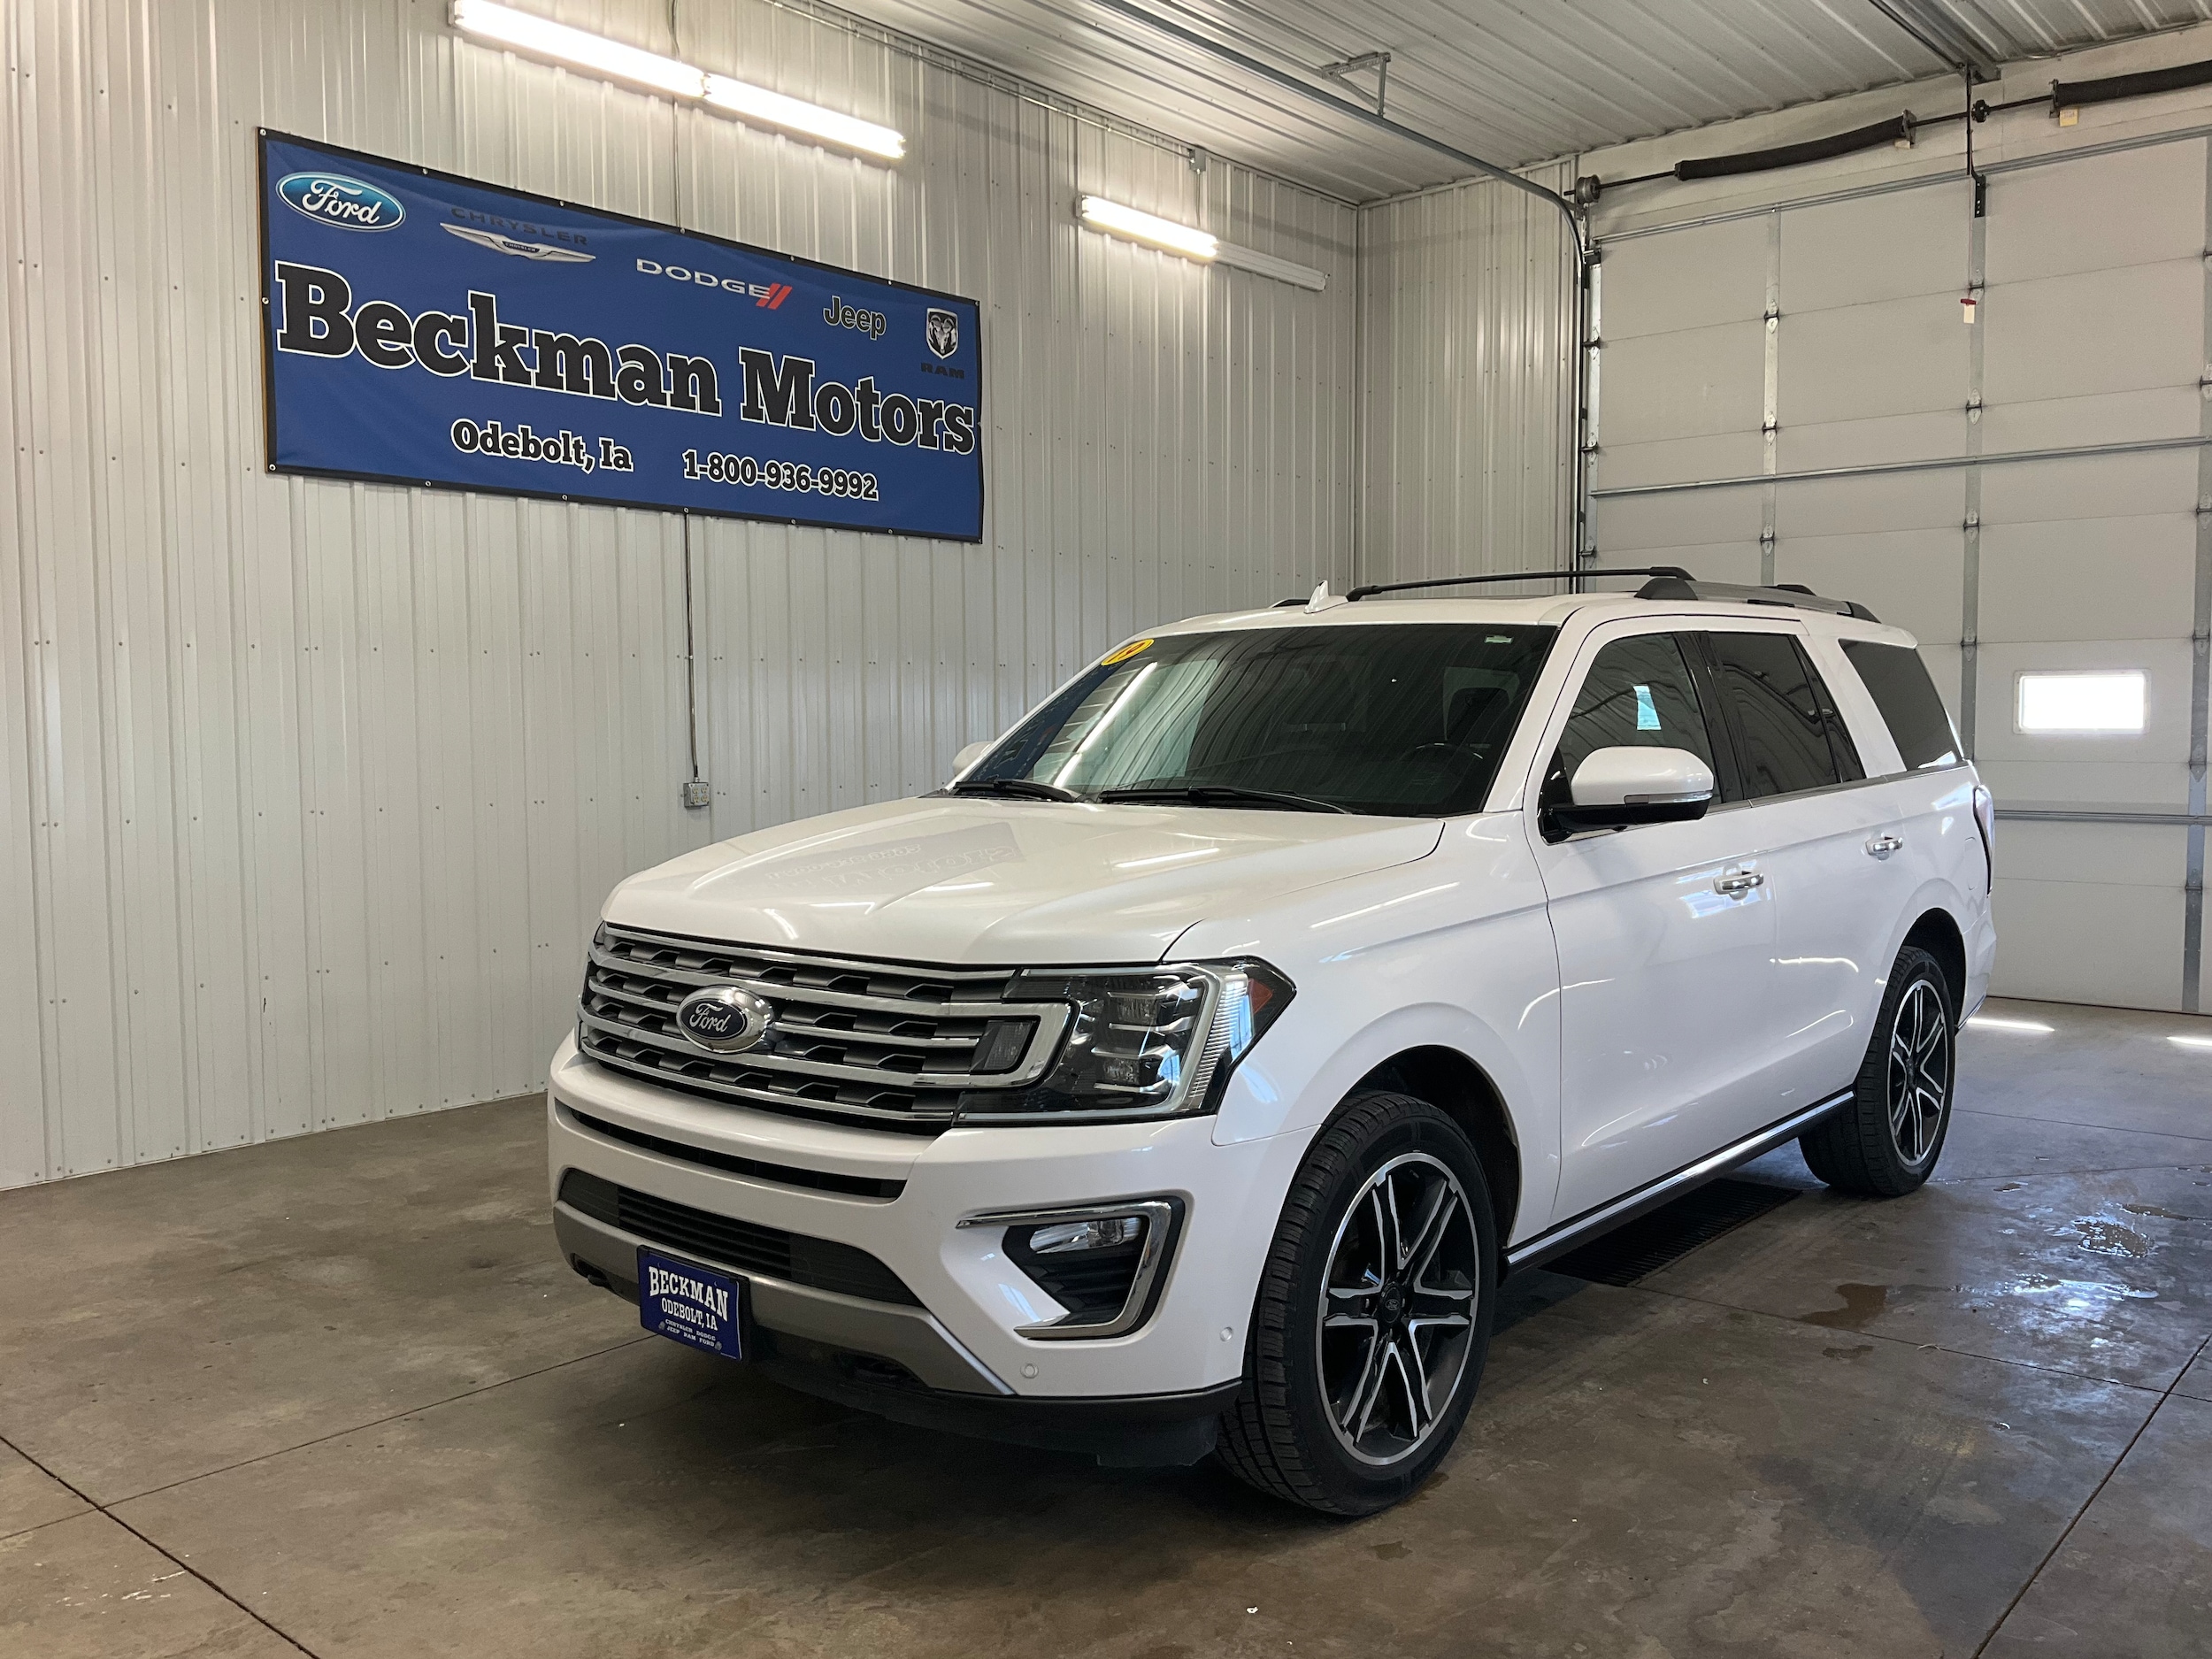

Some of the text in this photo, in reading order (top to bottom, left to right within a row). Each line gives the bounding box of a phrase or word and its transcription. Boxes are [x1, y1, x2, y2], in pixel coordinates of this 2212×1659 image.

[301, 178, 381, 226] Ford
[450, 206, 588, 246] CHRYSLER
[635, 257, 771, 301] DODGE
[823, 296, 887, 341] Jeep
[274, 259, 975, 455] Beckman Motors
[920, 362, 965, 380] RAM
[450, 418, 634, 475] Odebolt, Ia
[681, 449, 879, 502] 1-800-936-9992
[689, 1002, 732, 1033] Ford
[648, 1265, 729, 1323] BECKMAN
[661, 1297, 718, 1331] ODEBOLT, IA
